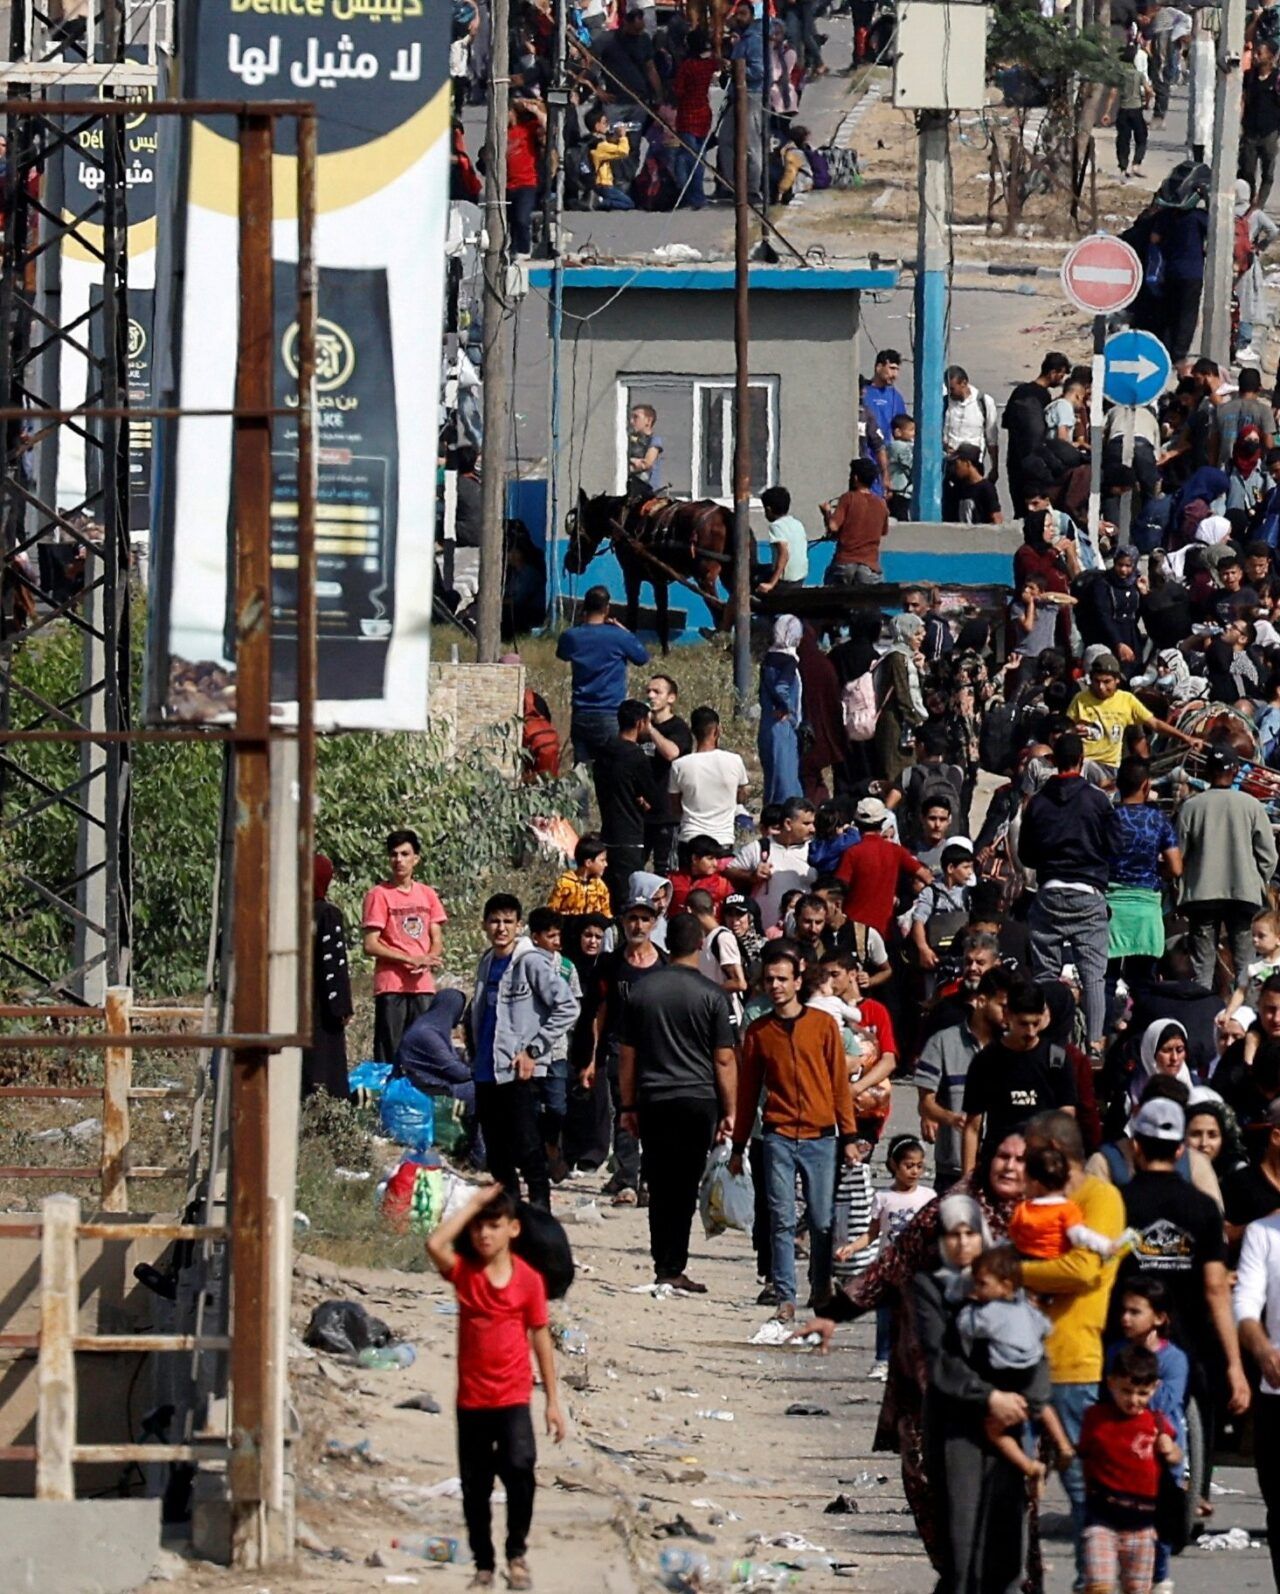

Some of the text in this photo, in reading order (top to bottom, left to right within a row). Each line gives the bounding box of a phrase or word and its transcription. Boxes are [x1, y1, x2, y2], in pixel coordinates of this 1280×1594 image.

[228, 33, 422, 88] لا مثيل لها
